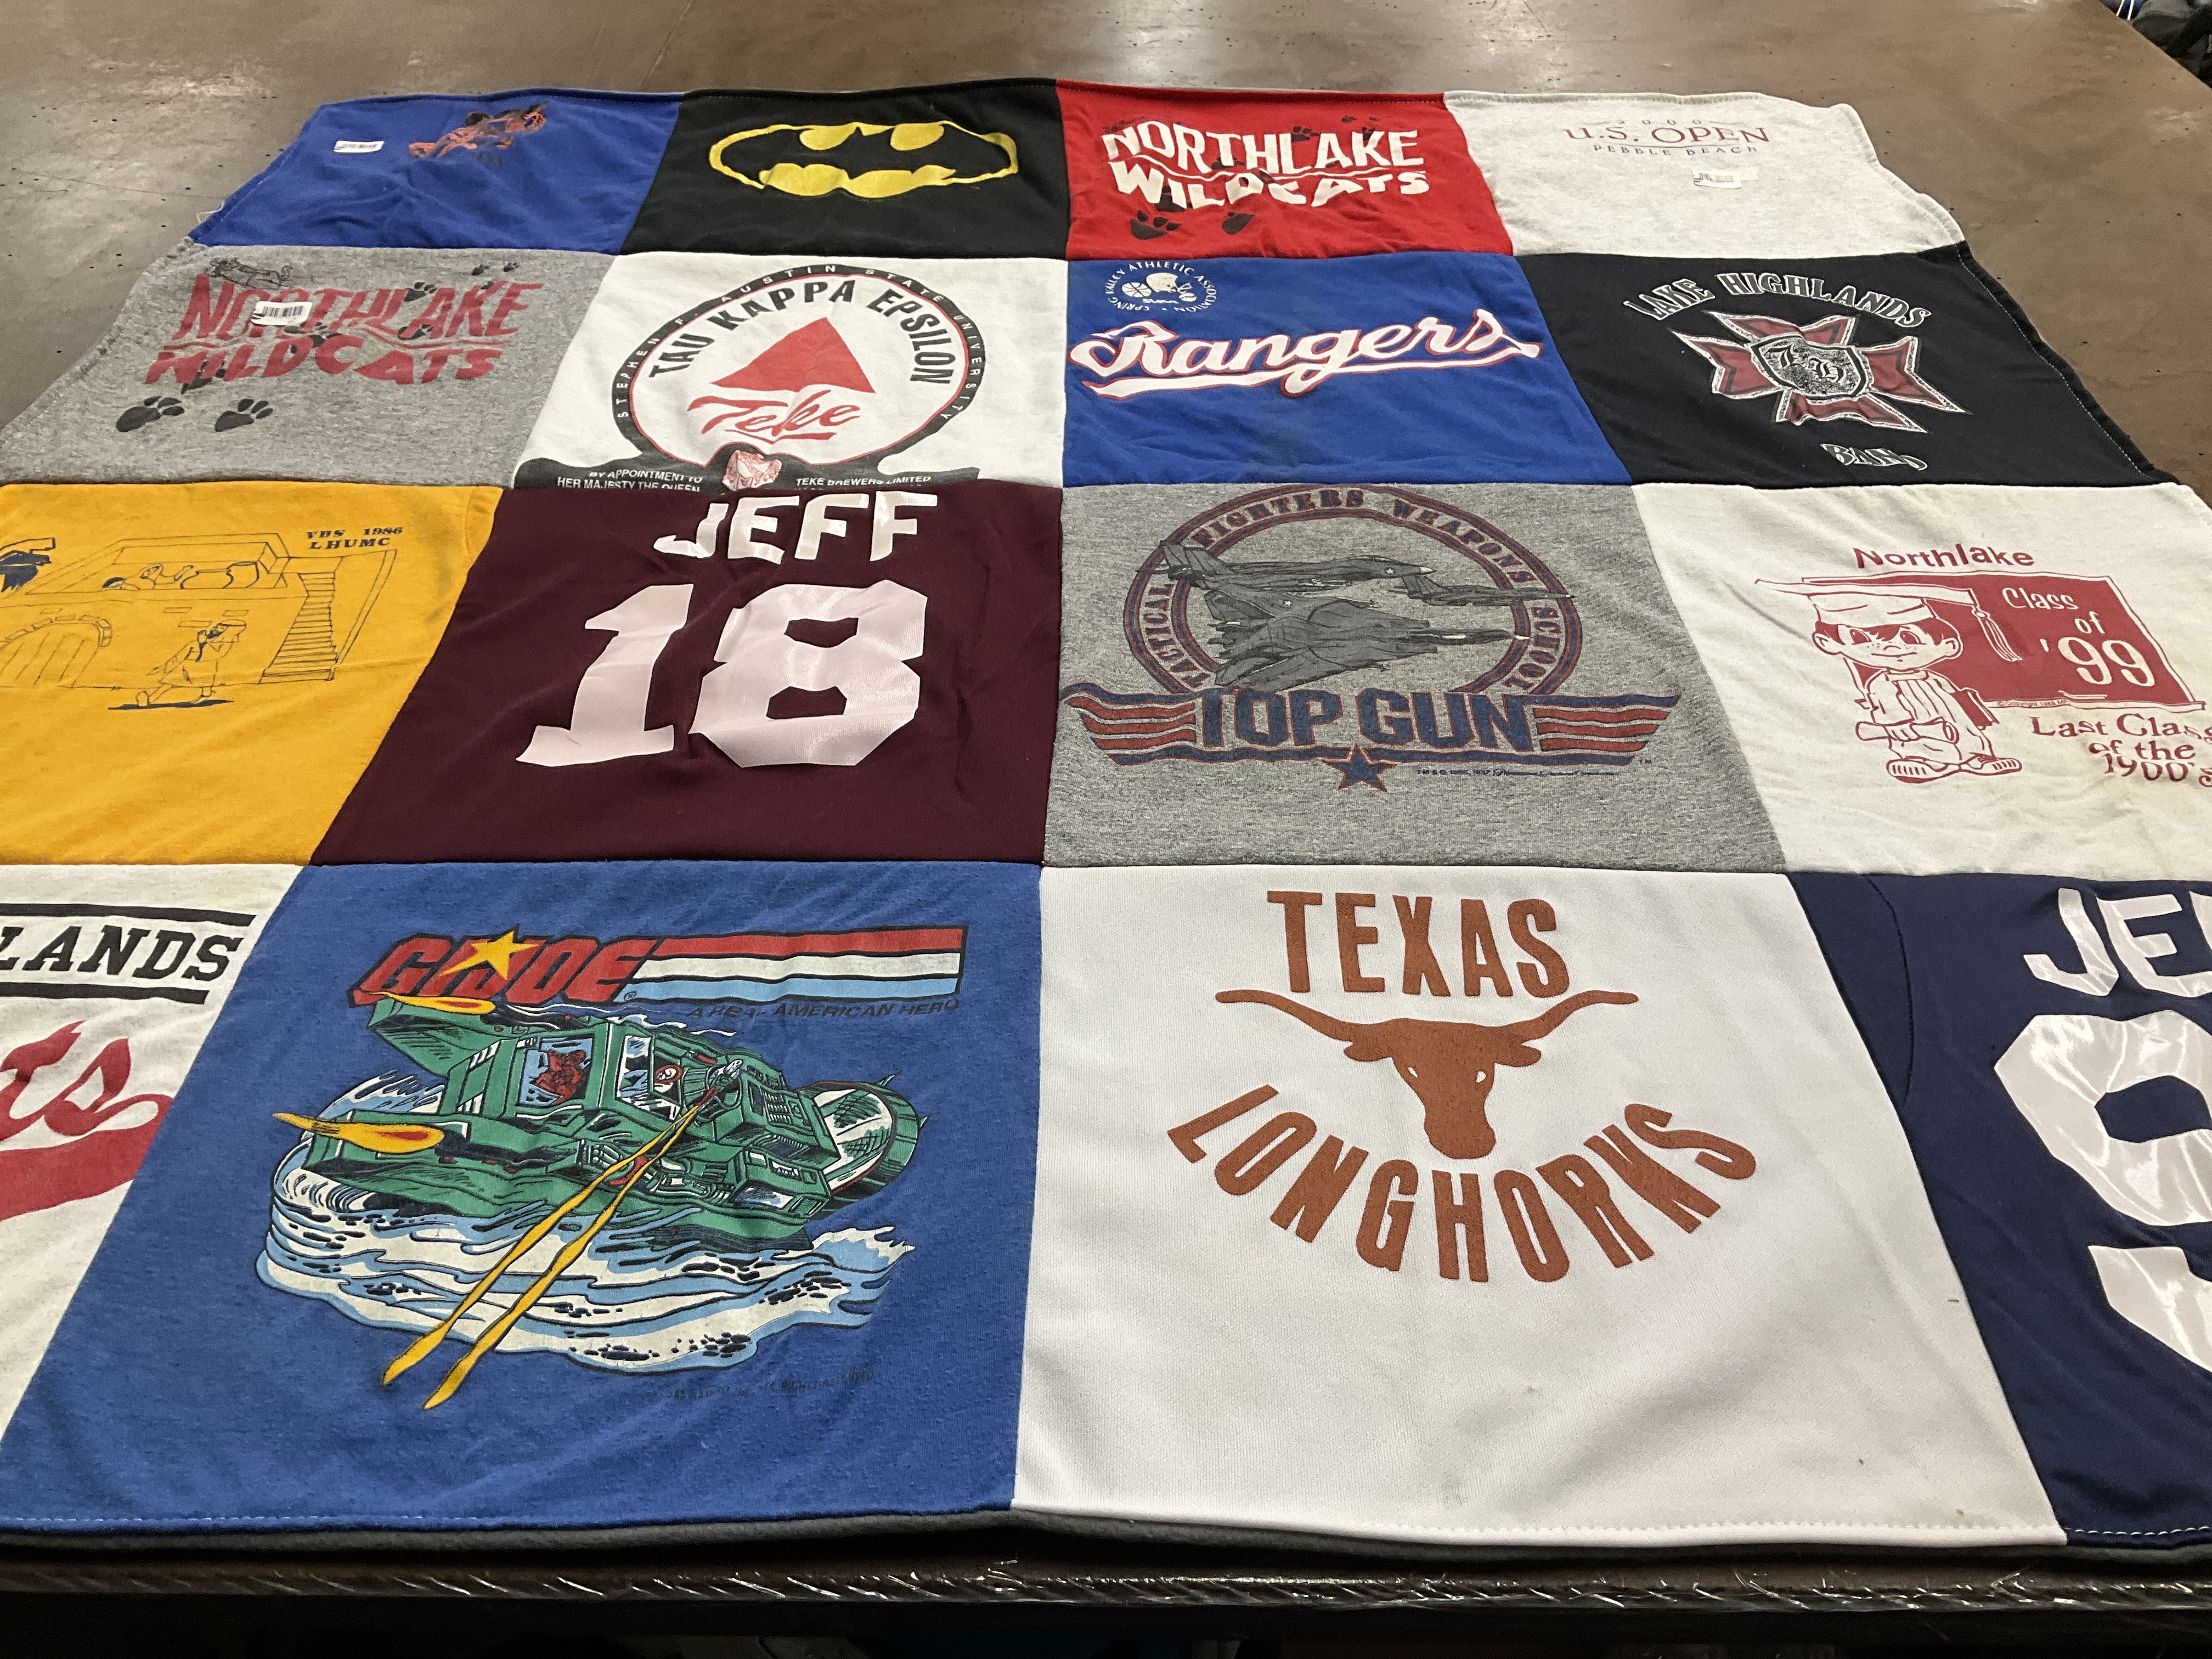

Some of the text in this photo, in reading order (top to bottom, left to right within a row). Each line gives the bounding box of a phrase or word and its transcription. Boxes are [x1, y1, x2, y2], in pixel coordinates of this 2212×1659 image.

[1101, 120, 1425, 174] NORTHLAKE
[1563, 126, 1770, 143] U.S. OPEN
[1593, 144, 1758, 156] PEBBLE BEACH
[1108, 161, 1430, 210] WILDCATS
[1105, 268, 1126, 295] VALLEY
[1128, 261, 1195, 276] ATHLETIC
[1623, 272, 1932, 328] LAKE HIGHLANDS
[616, 337, 660, 419] STEPHEN
[721, 264, 837, 303] AUSTIN
[865, 268, 945, 302] STATE
[939, 314, 983, 419] UNIVERSITY
[648, 279, 956, 384] TAU KAPPA EPSILON
[144, 331, 503, 385] WILDCATS
[1067, 308, 1543, 399] Rangers
[687, 390, 861, 437] Teke
[607, 469, 684, 482] APPOINTMENT
[1820, 443, 1928, 471] BAND
[557, 476, 582, 489] HER
[583, 478, 637, 489] MAJESTY
[637, 481, 659, 490] THE
[795, 477, 826, 487] TEKE
[885, 476, 932, 484] LIMITED
[306, 527, 403, 539] VBS 1986
[308, 537, 390, 550] LHUMC
[653, 490, 938, 565] JEFF
[1852, 543, 2035, 569] Northlake
[1143, 489, 1562, 691] TACTICAL FIGHTERS WEAPONS SCHOOL
[2002, 586, 2080, 611] Class
[2074, 611, 2106, 635] of
[515, 579, 928, 768] 18
[2041, 636, 2156, 688] '99
[1204, 688, 1345, 748] TOP
[1357, 688, 1535, 753] GUN
[2028, 715, 2109, 737] Last
[2088, 739, 2196, 760] of the
[1266, 890, 1571, 998] TEXAS
[686, 1006, 704, 1019] A
[772, 1002, 895, 1018] AMERICAN
[898, 998, 960, 1015] HERO
[1166, 1084, 1757, 1284] LONGHORNS
